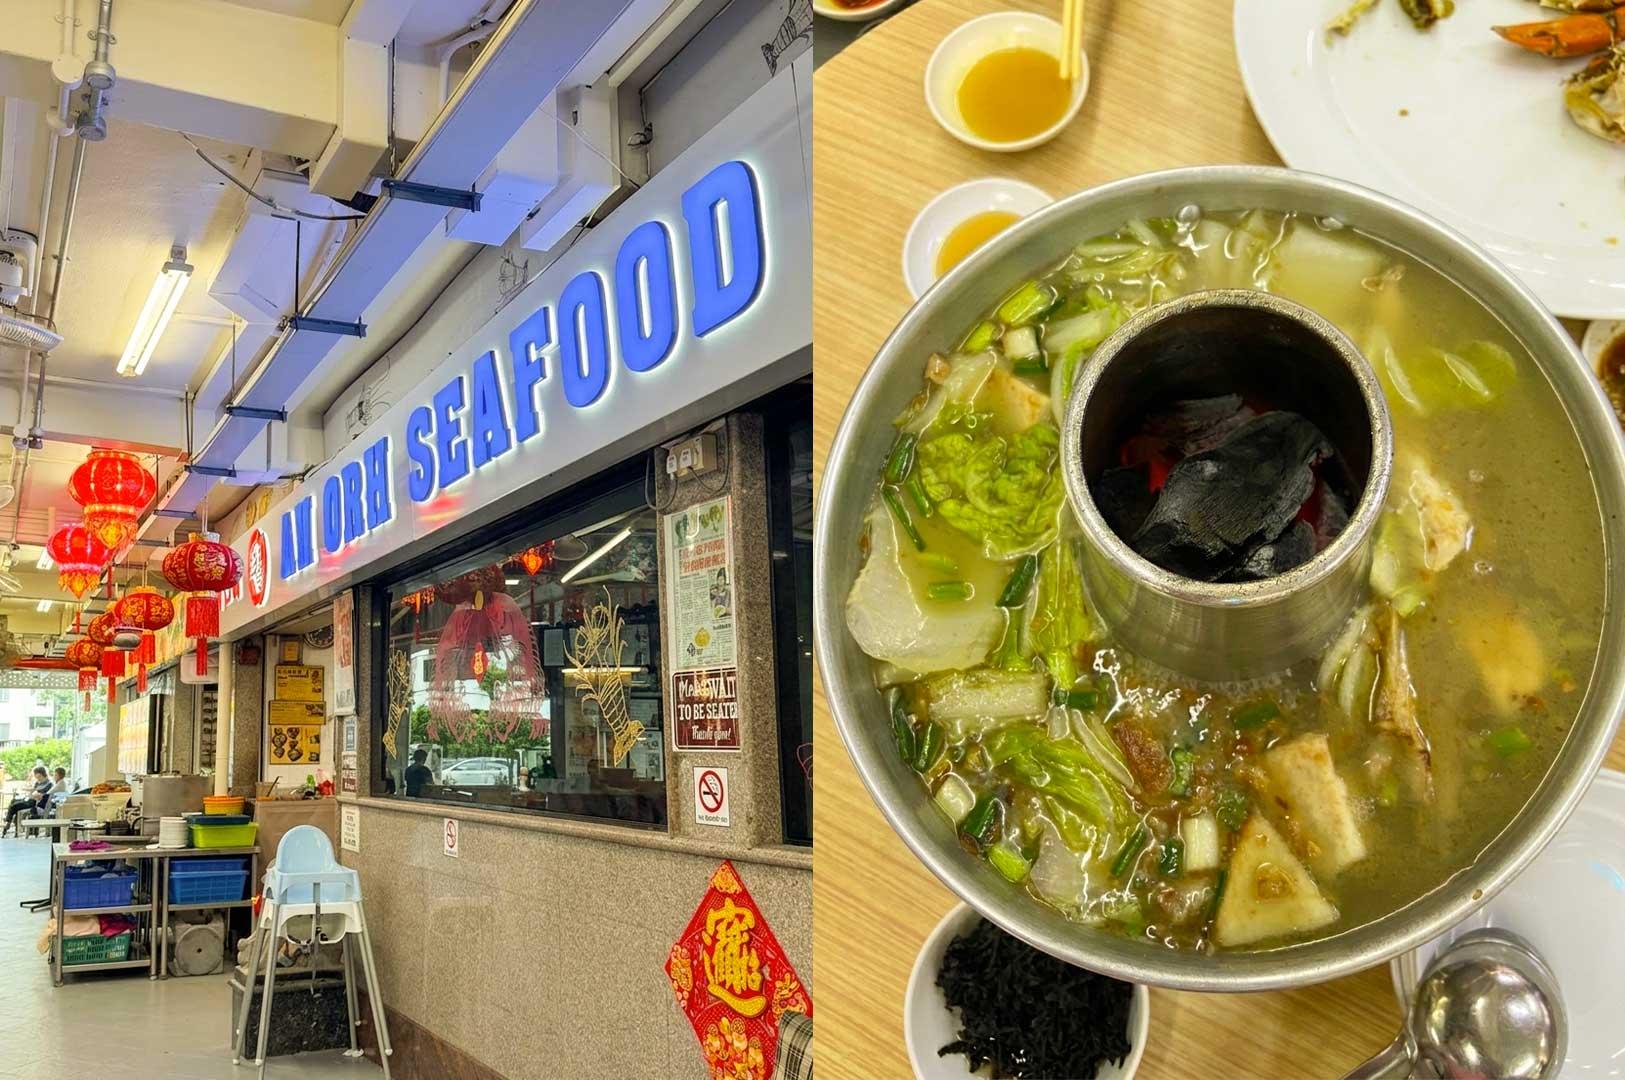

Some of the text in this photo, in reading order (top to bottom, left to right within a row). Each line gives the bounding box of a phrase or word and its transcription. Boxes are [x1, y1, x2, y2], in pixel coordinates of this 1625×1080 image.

[323, 436, 392, 553] ORH
[407, 160, 767, 503] SEAFOOD
[708, 677, 736, 699] WAIT
[678, 704, 691, 720] TO
[693, 703, 705, 720] BE
